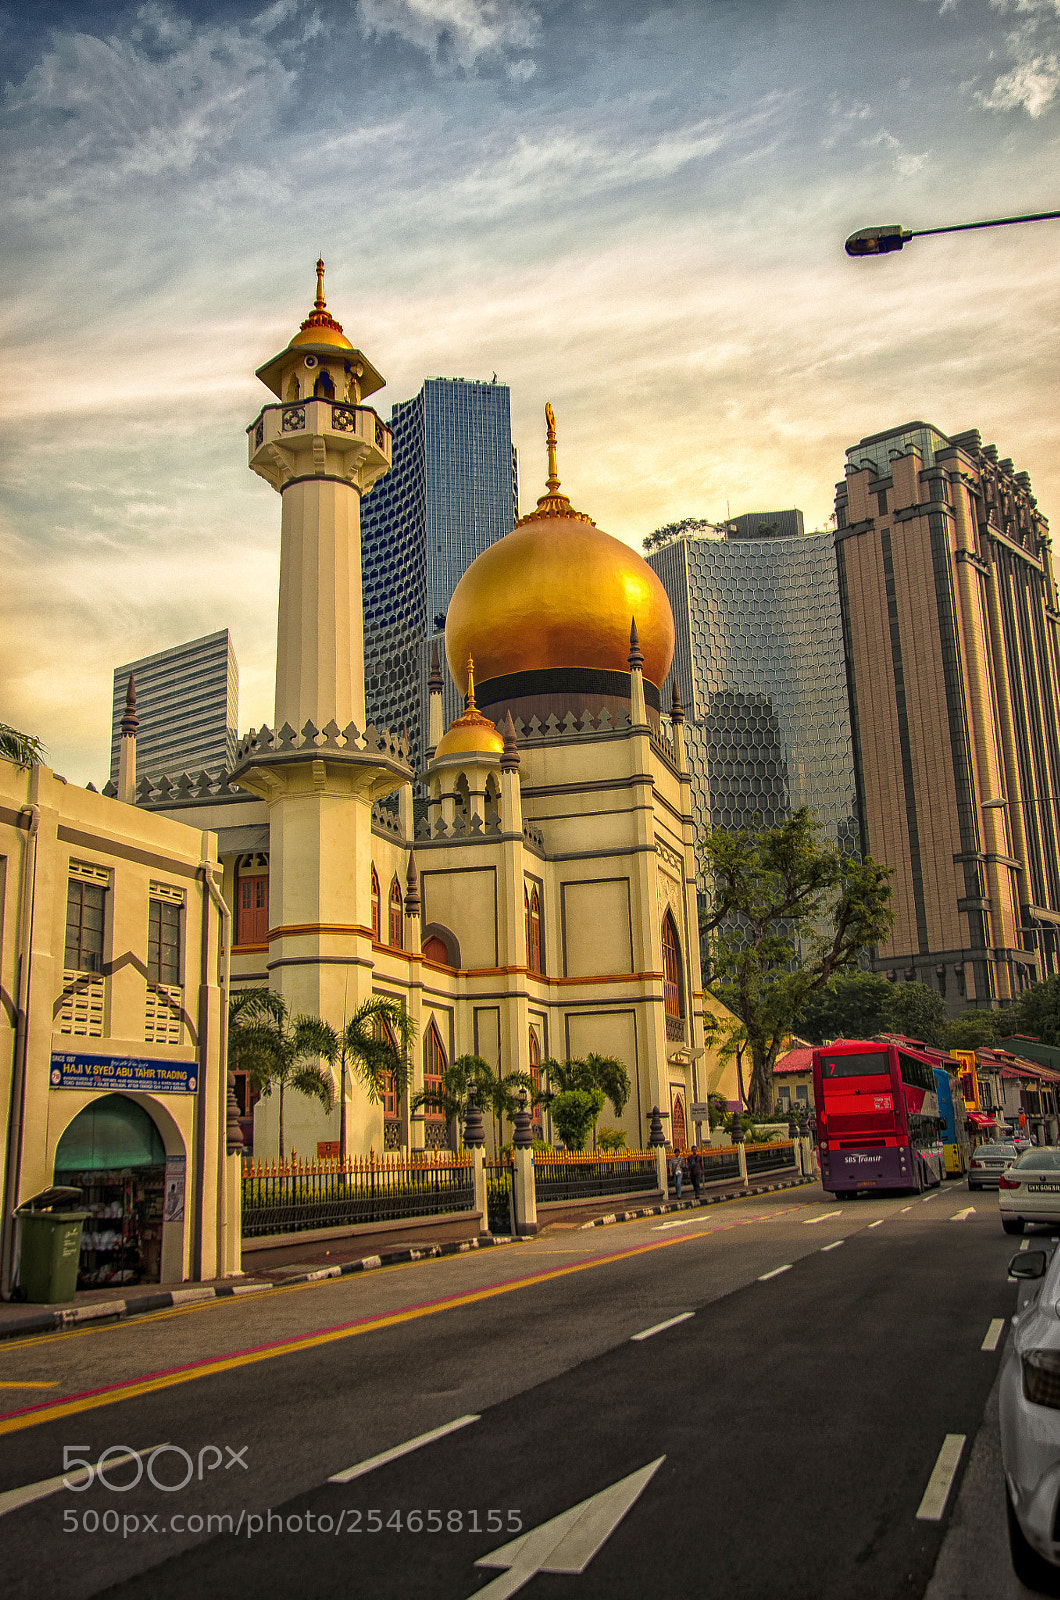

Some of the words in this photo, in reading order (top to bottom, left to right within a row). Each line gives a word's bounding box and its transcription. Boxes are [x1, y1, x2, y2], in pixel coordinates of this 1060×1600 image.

[63, 1063, 83, 1074] HAJI
[93, 1065, 115, 1076] SYED
[116, 1067, 133, 1077] ABU
[135, 1068, 155, 1078] TAHIR
[157, 1069, 187, 1080] TRADING
[829, 1063, 836, 1075] 7
[857, 1154, 882, 1164] Transit
